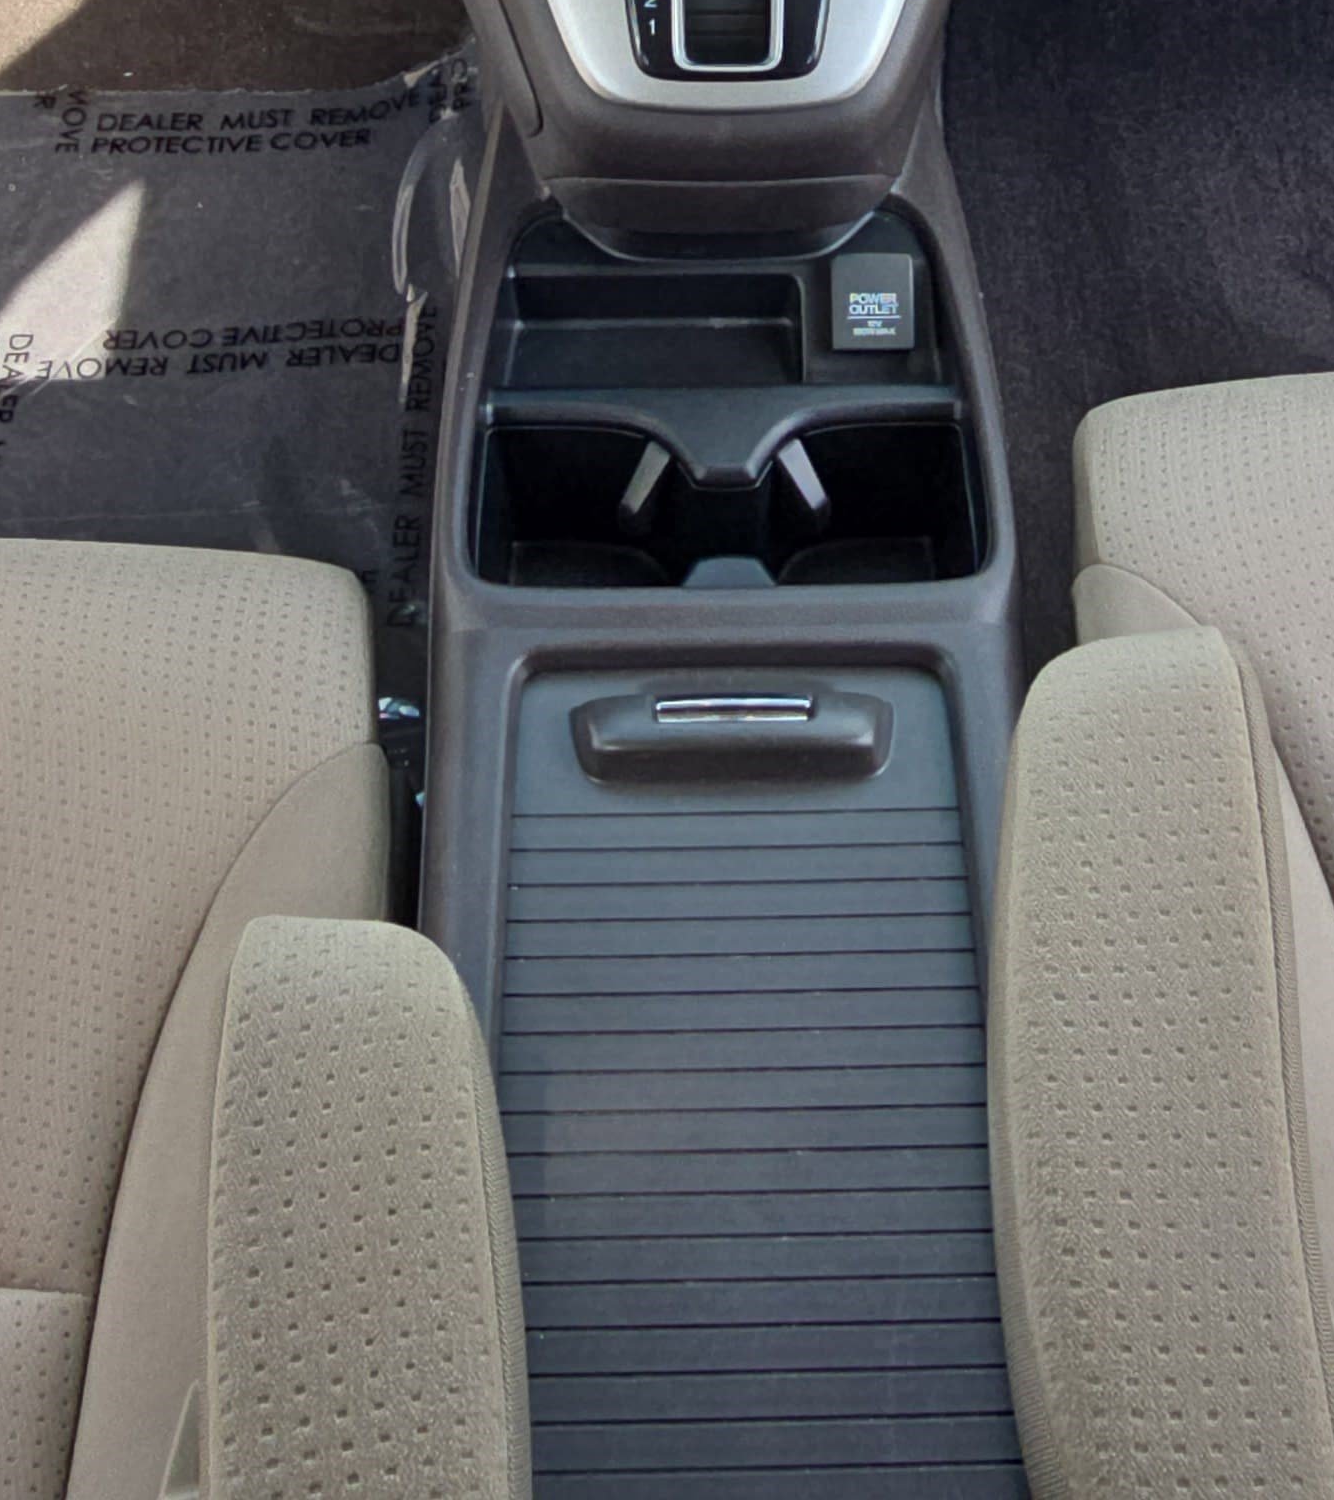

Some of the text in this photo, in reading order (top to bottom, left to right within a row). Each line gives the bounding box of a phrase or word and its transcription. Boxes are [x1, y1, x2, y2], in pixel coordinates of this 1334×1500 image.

[648, 19, 656, 36] 1
[97, 90, 420, 133] DEALER MUST REMOVE
[91, 129, 371, 155] PROTECTIVE COVER
[848, 304, 898, 315] OUTLET
[849, 293, 897, 304] POWER
[103, 315, 403, 351] PROTECTIVE COVER
[37, 340, 402, 380] DEALER MUST REMOVE
[400, 428, 429, 499] MUST
